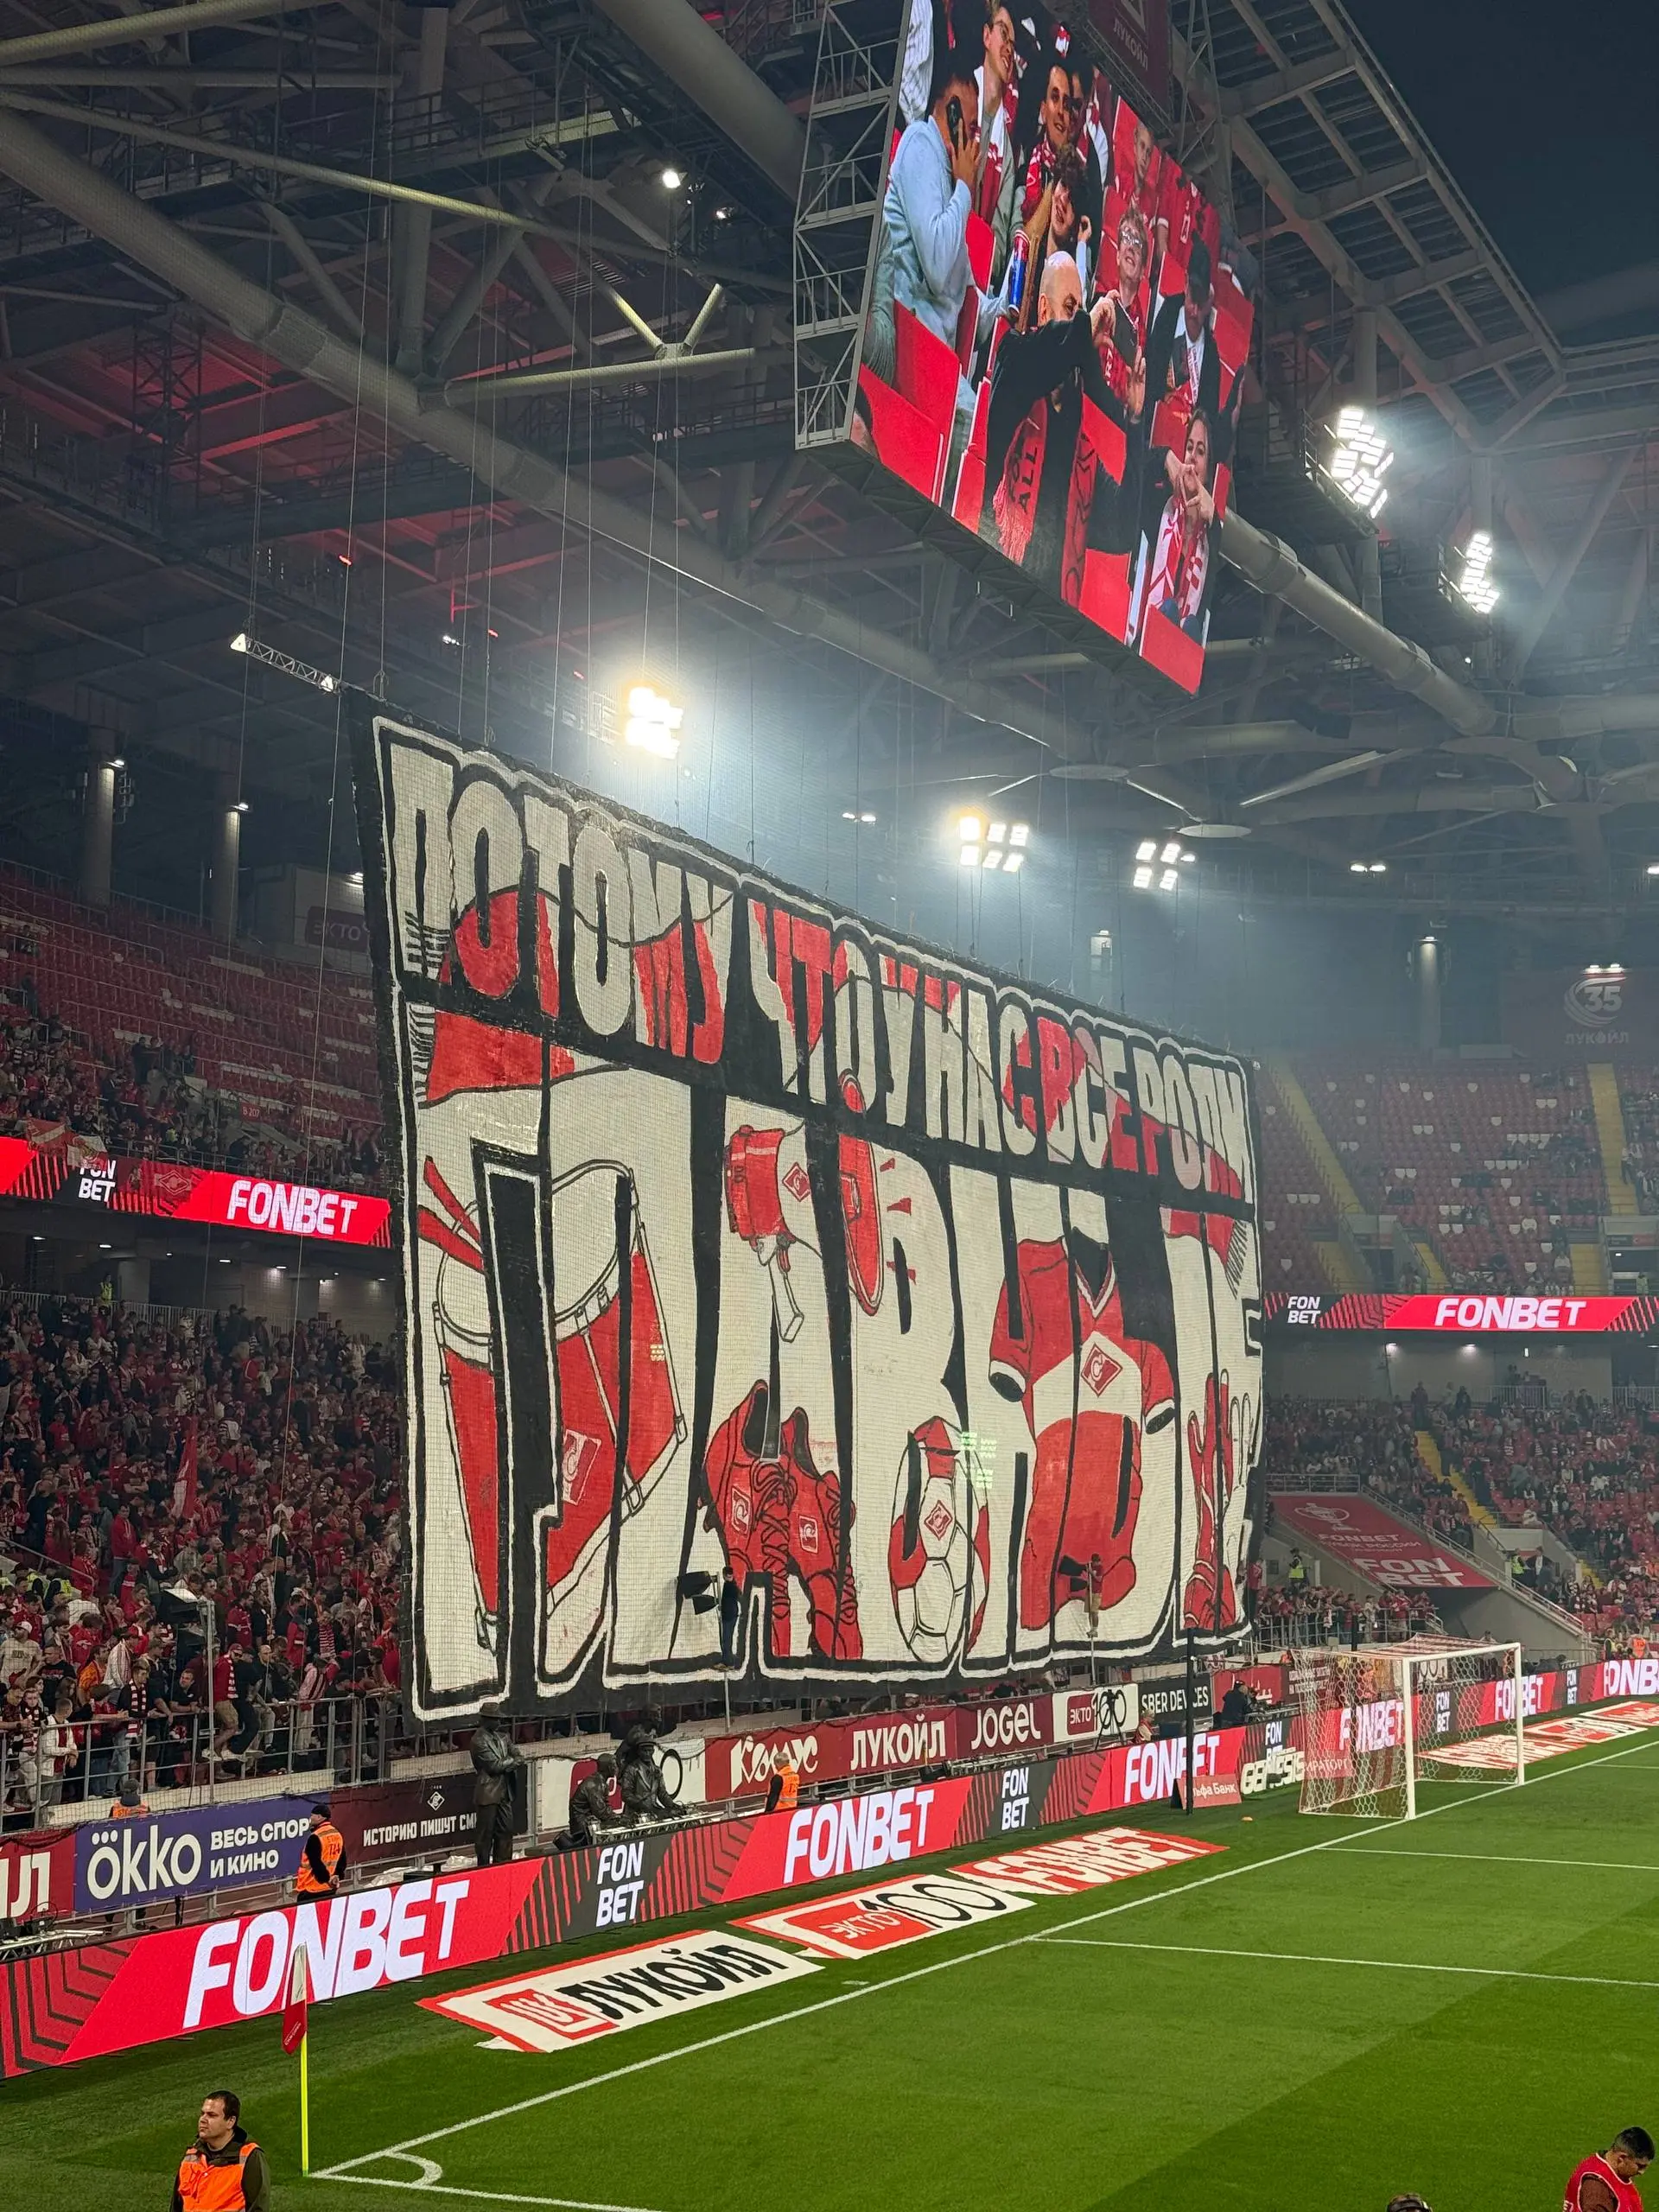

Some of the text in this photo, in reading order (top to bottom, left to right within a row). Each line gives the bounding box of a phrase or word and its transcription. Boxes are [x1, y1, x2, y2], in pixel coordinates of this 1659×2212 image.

[389, 741, 733, 1065] ПОТОМУ
[747, 899, 876, 1114] ЧТО
[1584, 986, 1624, 1013] 35
[79, 1178, 116, 1202] BET
[226, 1180, 359, 1236] FONBET
[1287, 1296, 1320, 1309] FON
[1287, 1310, 1320, 1325] BET
[1434, 1297, 1587, 1330] FONBET
[1353, 1557, 1452, 1573] FON
[1376, 1572, 1465, 1586] BET
[1567, 1669, 1577, 1686] FON
[1604, 1659, 1659, 1697] FONB
[1141, 1691, 1168, 1714] SBER
[1436, 1691, 1450, 1712] FON
[1567, 1687, 1577, 1705] BET
[1070, 1707, 1092, 1725] ЭКТО
[1339, 1700, 1405, 1752] FNBET
[1436, 1712, 1450, 1732] BET
[850, 1713, 946, 1771] ЛУКОЙЛ
[1265, 1720, 1282, 1745] FON
[1001, 1767, 1029, 1800] FON
[1001, 1797, 1029, 1831] BET
[210, 1818, 312, 1851] ВЕСЬ СПОР
[363, 1821, 418, 1847] ИСТОРИЮ
[420, 1815, 457, 1837] ПИШУТ
[783, 1786, 934, 1884] FONBET
[210, 1849, 279, 1879] И КИНО
[596, 1840, 645, 1885] FON
[973, 1827, 1211, 1892] FONBET
[595, 1880, 645, 1927] BET
[818, 1912, 901, 1940] ЭКТО
[182, 1878, 471, 2029] FONBET
[555, 1944, 789, 2020] ЛУКОЙЛ
